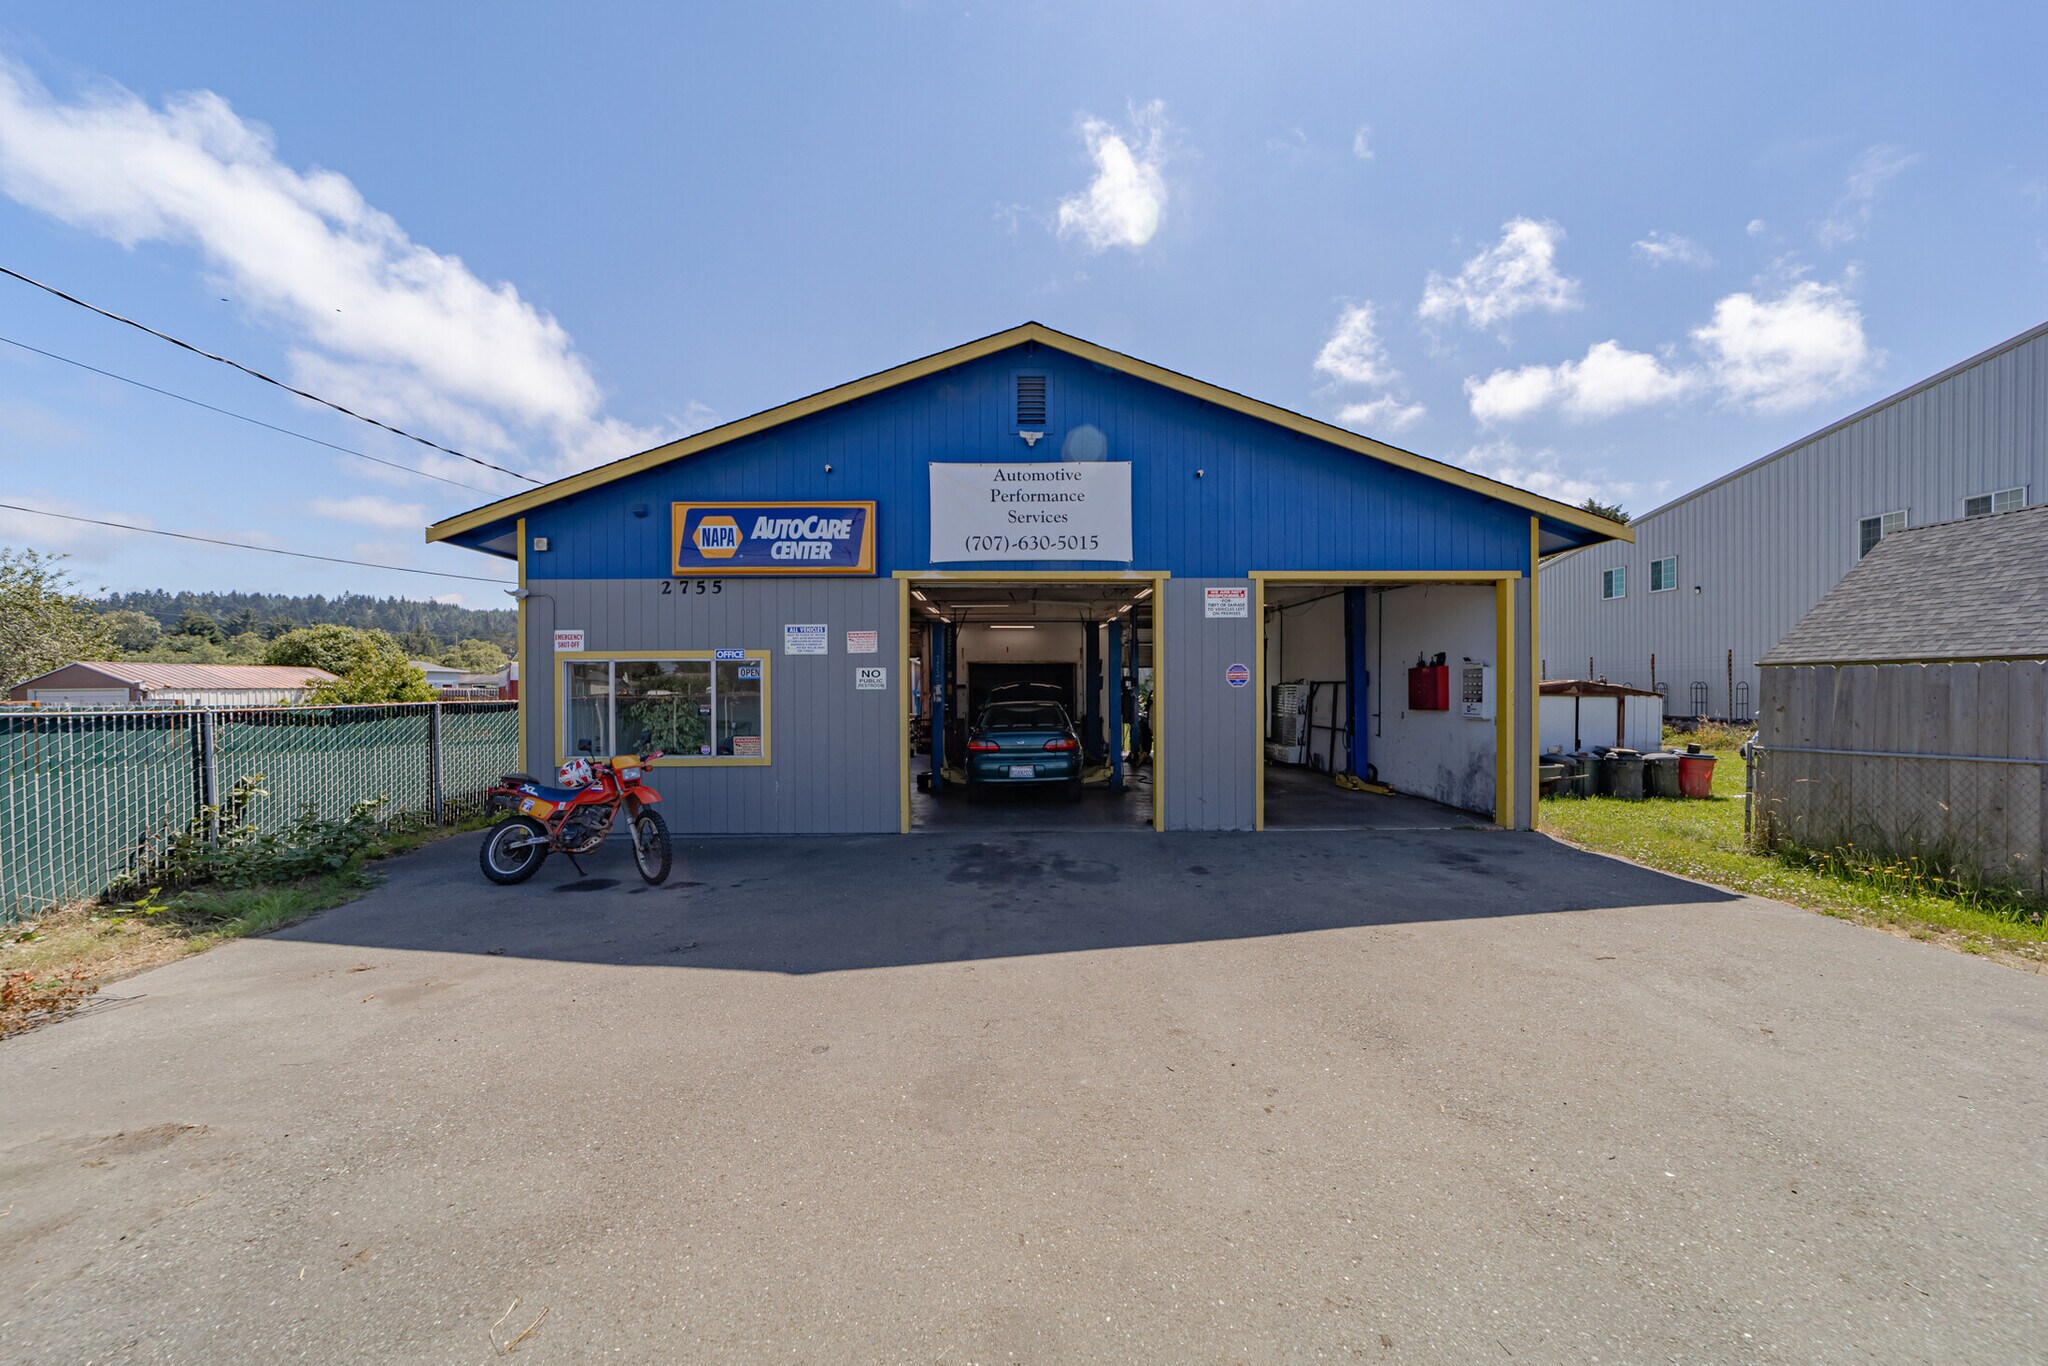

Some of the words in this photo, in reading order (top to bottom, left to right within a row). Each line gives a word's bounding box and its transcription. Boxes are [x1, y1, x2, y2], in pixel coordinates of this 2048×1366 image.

[993, 468, 1082, 482] Automotive
[990, 488, 1085, 502] Performance
[1008, 509, 1068, 523] Services
[702, 527, 735, 547] NAPA
[965, 534, 1099, 553] (707)-630-5015
[770, 541, 833, 560] CENTER
[661, 580, 722, 595] 2755
[717, 650, 744, 659] OFFICE
[740, 668, 760, 677] OPEN
[861, 669, 881, 678] NO
[520, 783, 538, 796] XL
